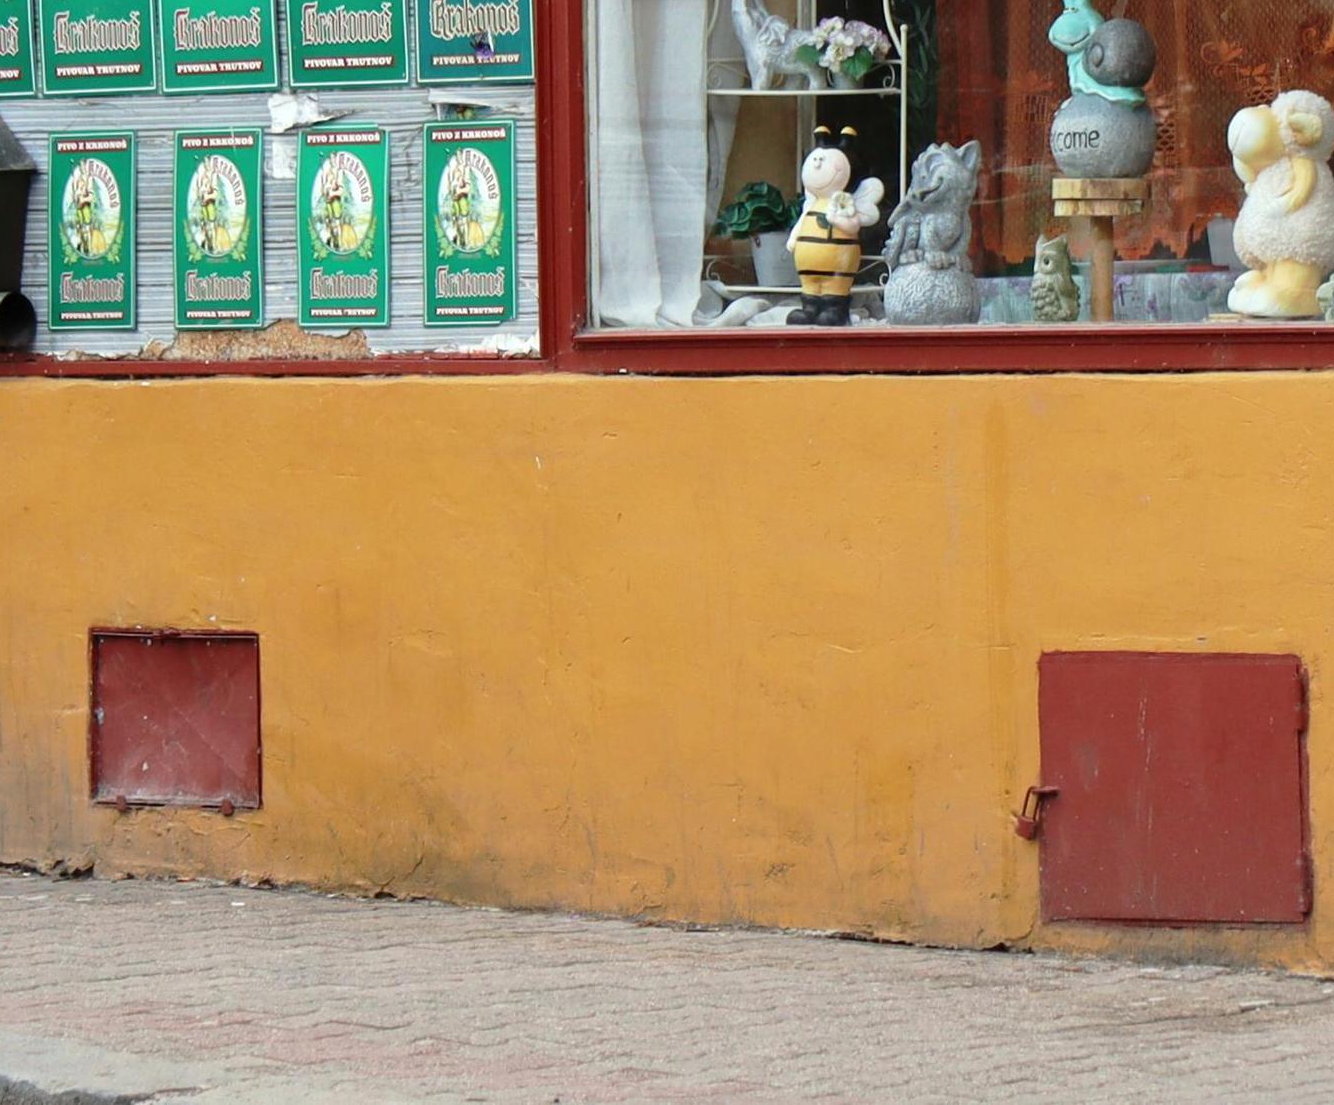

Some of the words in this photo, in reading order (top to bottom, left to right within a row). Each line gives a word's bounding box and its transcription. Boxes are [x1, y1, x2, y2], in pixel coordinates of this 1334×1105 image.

[304, 58, 345, 68] PIVOVAR
[347, 56, 392, 67] TRUTNOV
[433, 56, 474, 65] PIVOVAR
[57, 67, 95, 77] PIVOVAR
[97, 64, 141, 75] TRUTNOV
[177, 64, 216, 74] PIVOVAR
[219, 61, 262, 71] TRUTNOV
